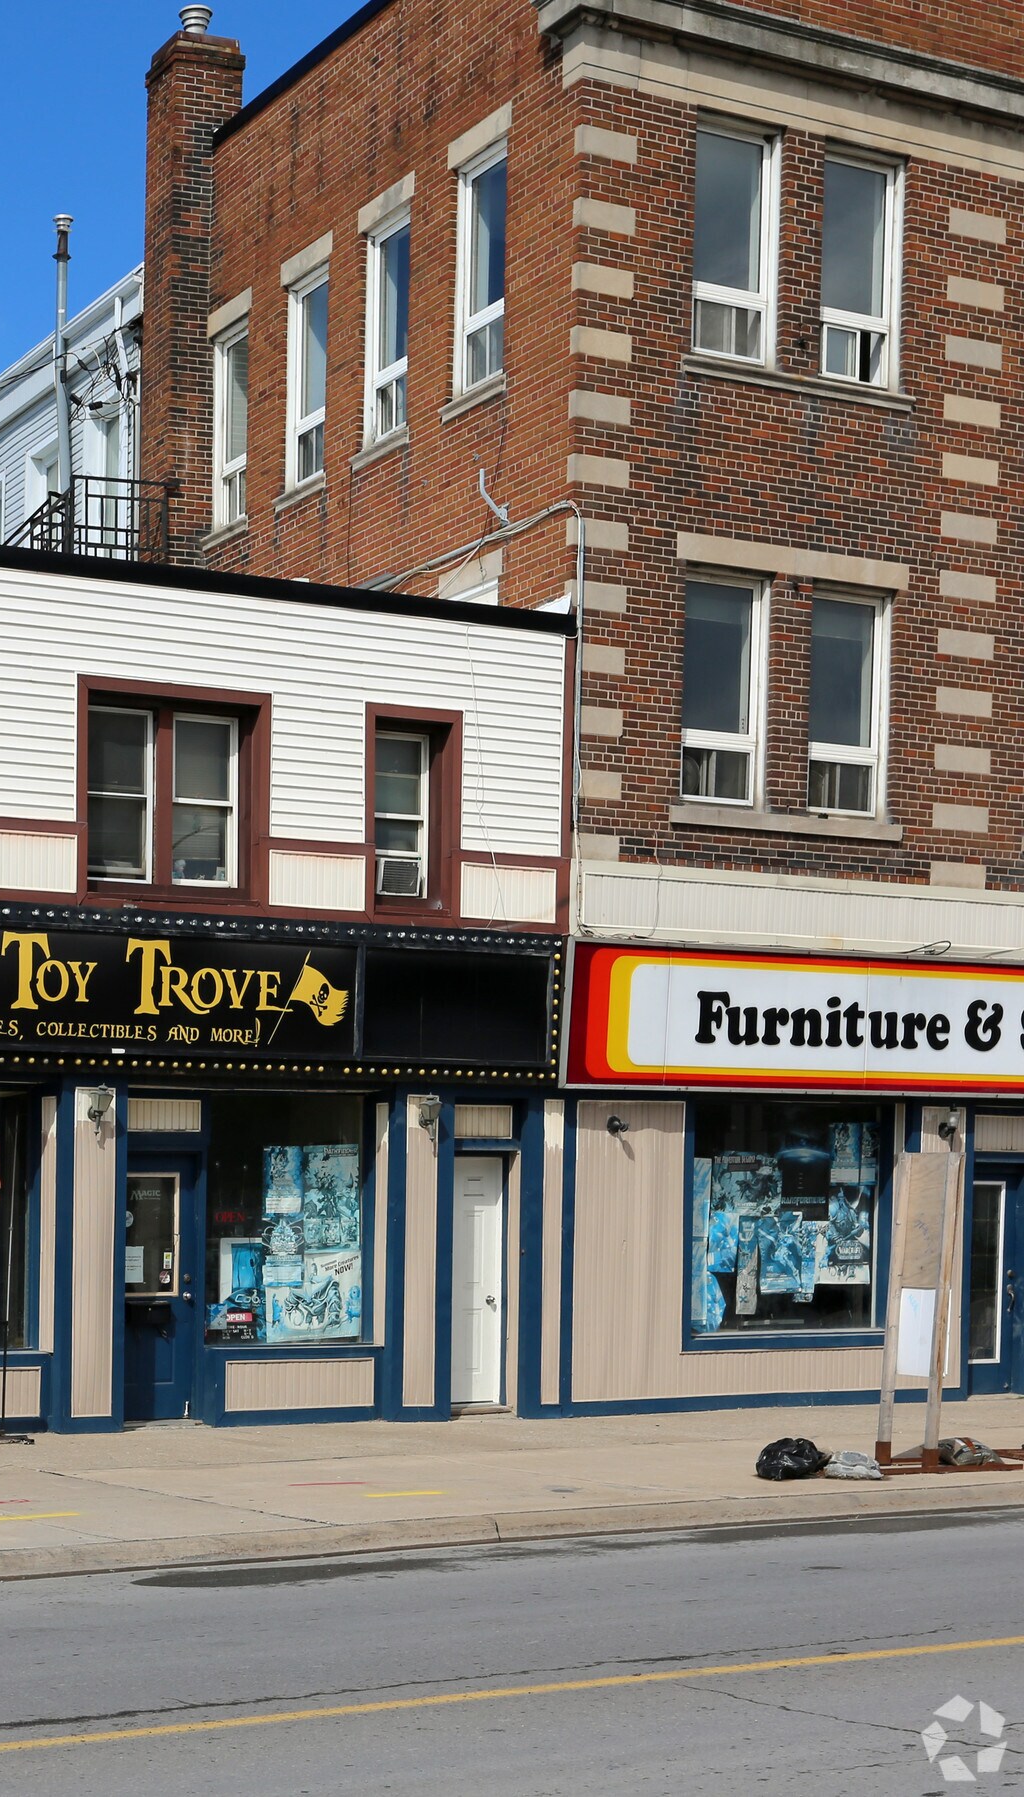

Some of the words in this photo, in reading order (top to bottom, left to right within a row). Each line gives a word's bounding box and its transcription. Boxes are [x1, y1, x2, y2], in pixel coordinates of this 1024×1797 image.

[1, 931, 98, 1010] TOY
[125, 937, 293, 1015] TROVE
[36, 1021, 157, 1042] COLLECTIBLES
[166, 1024, 200, 1044] AND
[210, 1017, 261, 1048] MORE!
[694, 990, 951, 1051] Furniture
[964, 999, 1004, 1052] &
